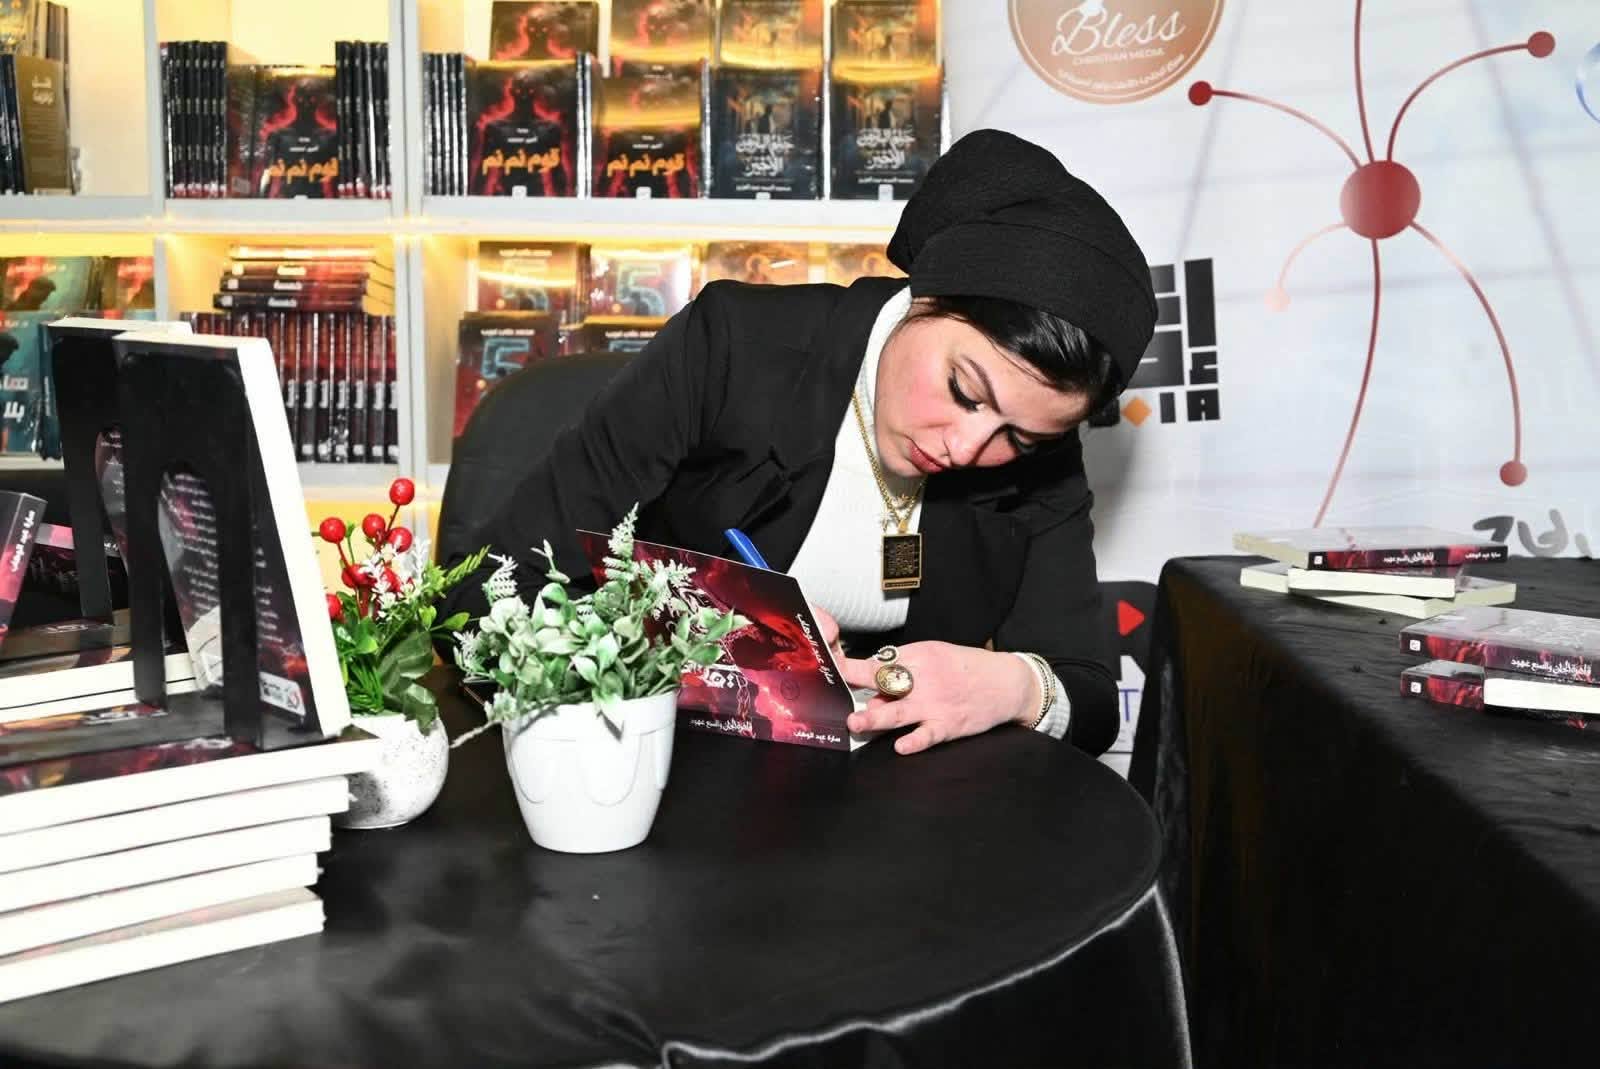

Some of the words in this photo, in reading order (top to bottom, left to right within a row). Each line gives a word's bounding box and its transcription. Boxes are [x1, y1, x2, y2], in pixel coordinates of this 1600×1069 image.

[1051, 7, 1187, 56] Bless
[795, 613, 819, 647] الوهاب
[812, 647, 824, 664] عبد
[818, 665, 835, 685] سارة
[827, 734, 841, 742] سارة
